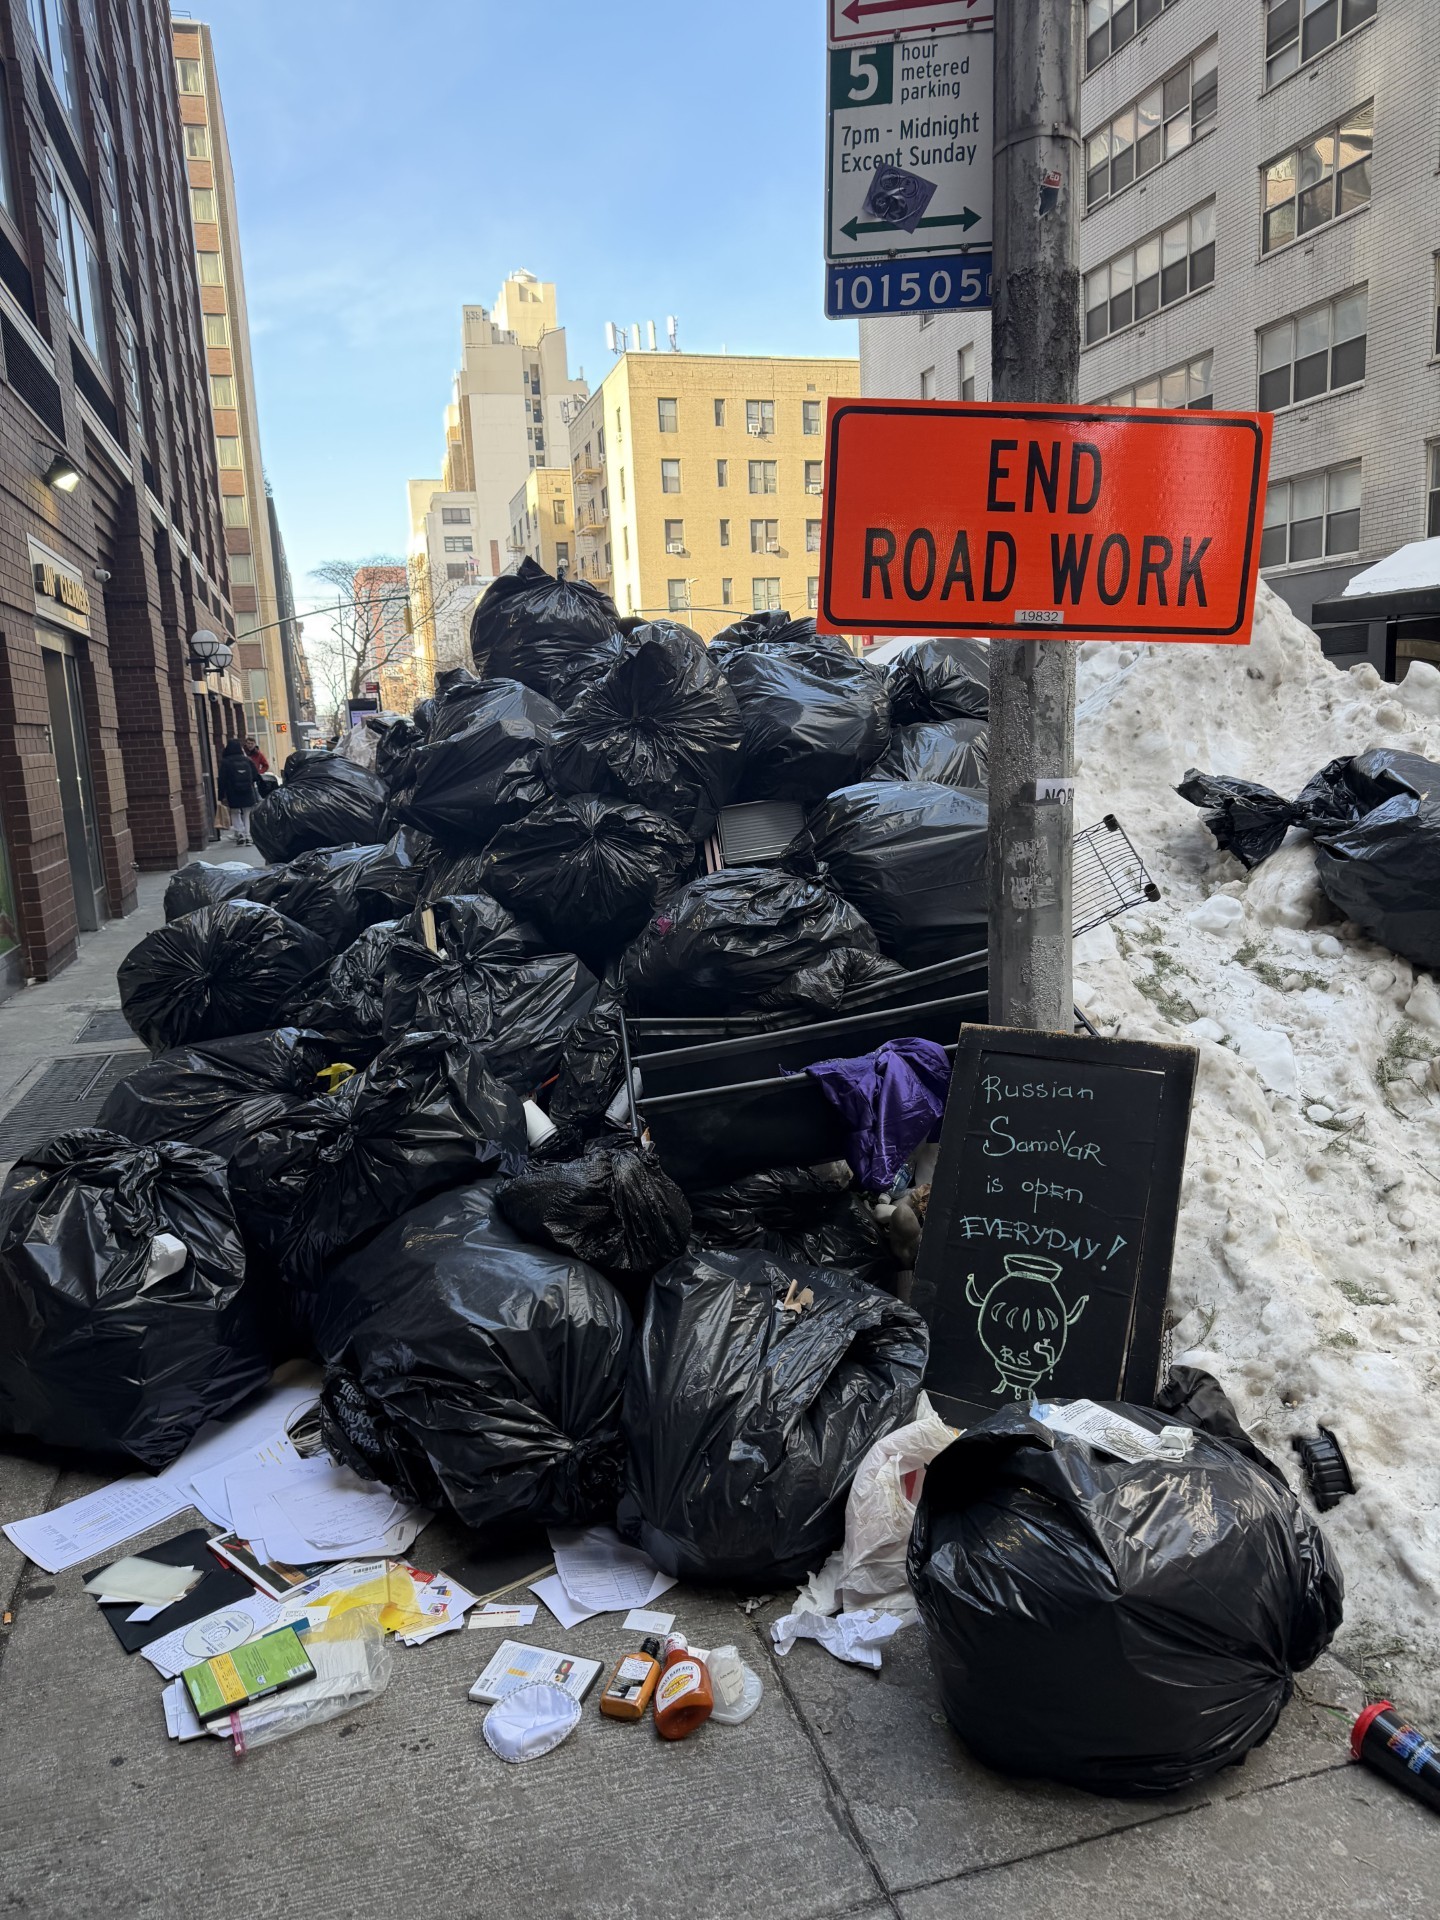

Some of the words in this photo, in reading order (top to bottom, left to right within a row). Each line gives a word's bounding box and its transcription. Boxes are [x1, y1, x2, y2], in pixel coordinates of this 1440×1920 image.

[900, 43, 939, 61] hour
[847, 47, 879, 101] 5
[900, 57, 970, 81] metered
[900, 79, 961, 105] parking
[841, 125, 880, 149] 7pm
[899, 112, 980, 140] Midnight
[841, 149, 903, 173] Except
[909, 143, 977, 166] Sunday
[835, 268, 982, 310] 101505
[986, 439, 1103, 515] END
[862, 527, 1017, 602] ROAD
[1050, 532, 1213, 608] WORK
[1020, 611, 1059, 623] 19832
[981, 1074, 1095, 1104] Russian
[986, 1176, 1004, 1194] is
[999, 1344, 1033, 1367] RS
